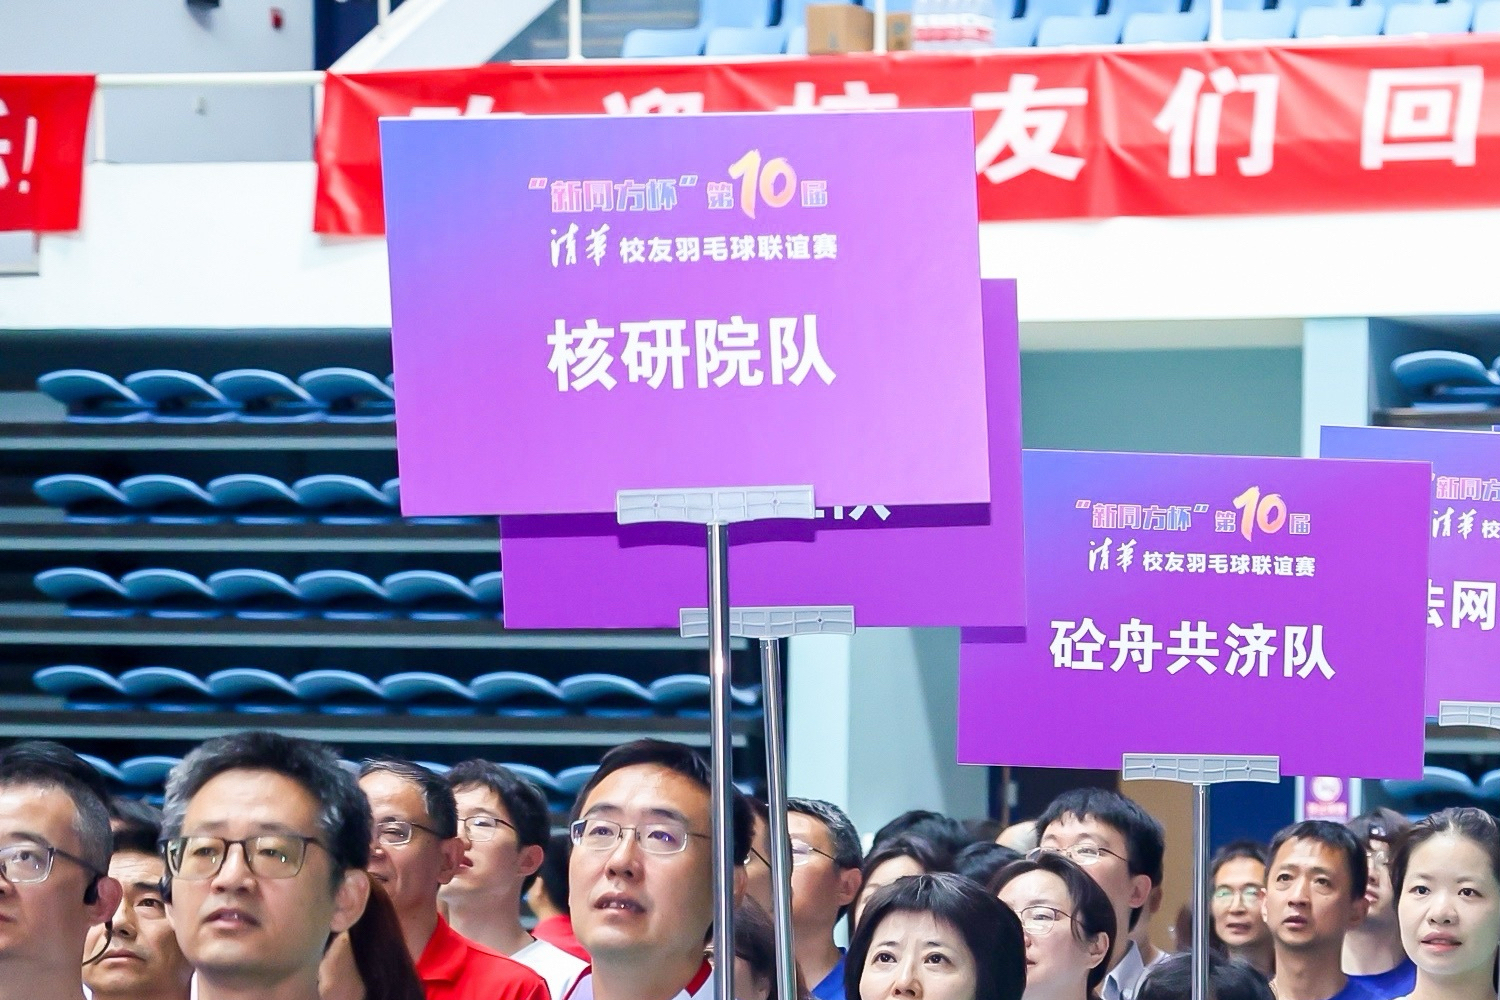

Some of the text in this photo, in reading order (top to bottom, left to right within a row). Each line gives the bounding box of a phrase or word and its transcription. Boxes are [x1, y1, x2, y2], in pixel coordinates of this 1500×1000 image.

[546, 314, 837, 392] 核研院队
[1049, 617, 1336, 680] 砼舟共济队
